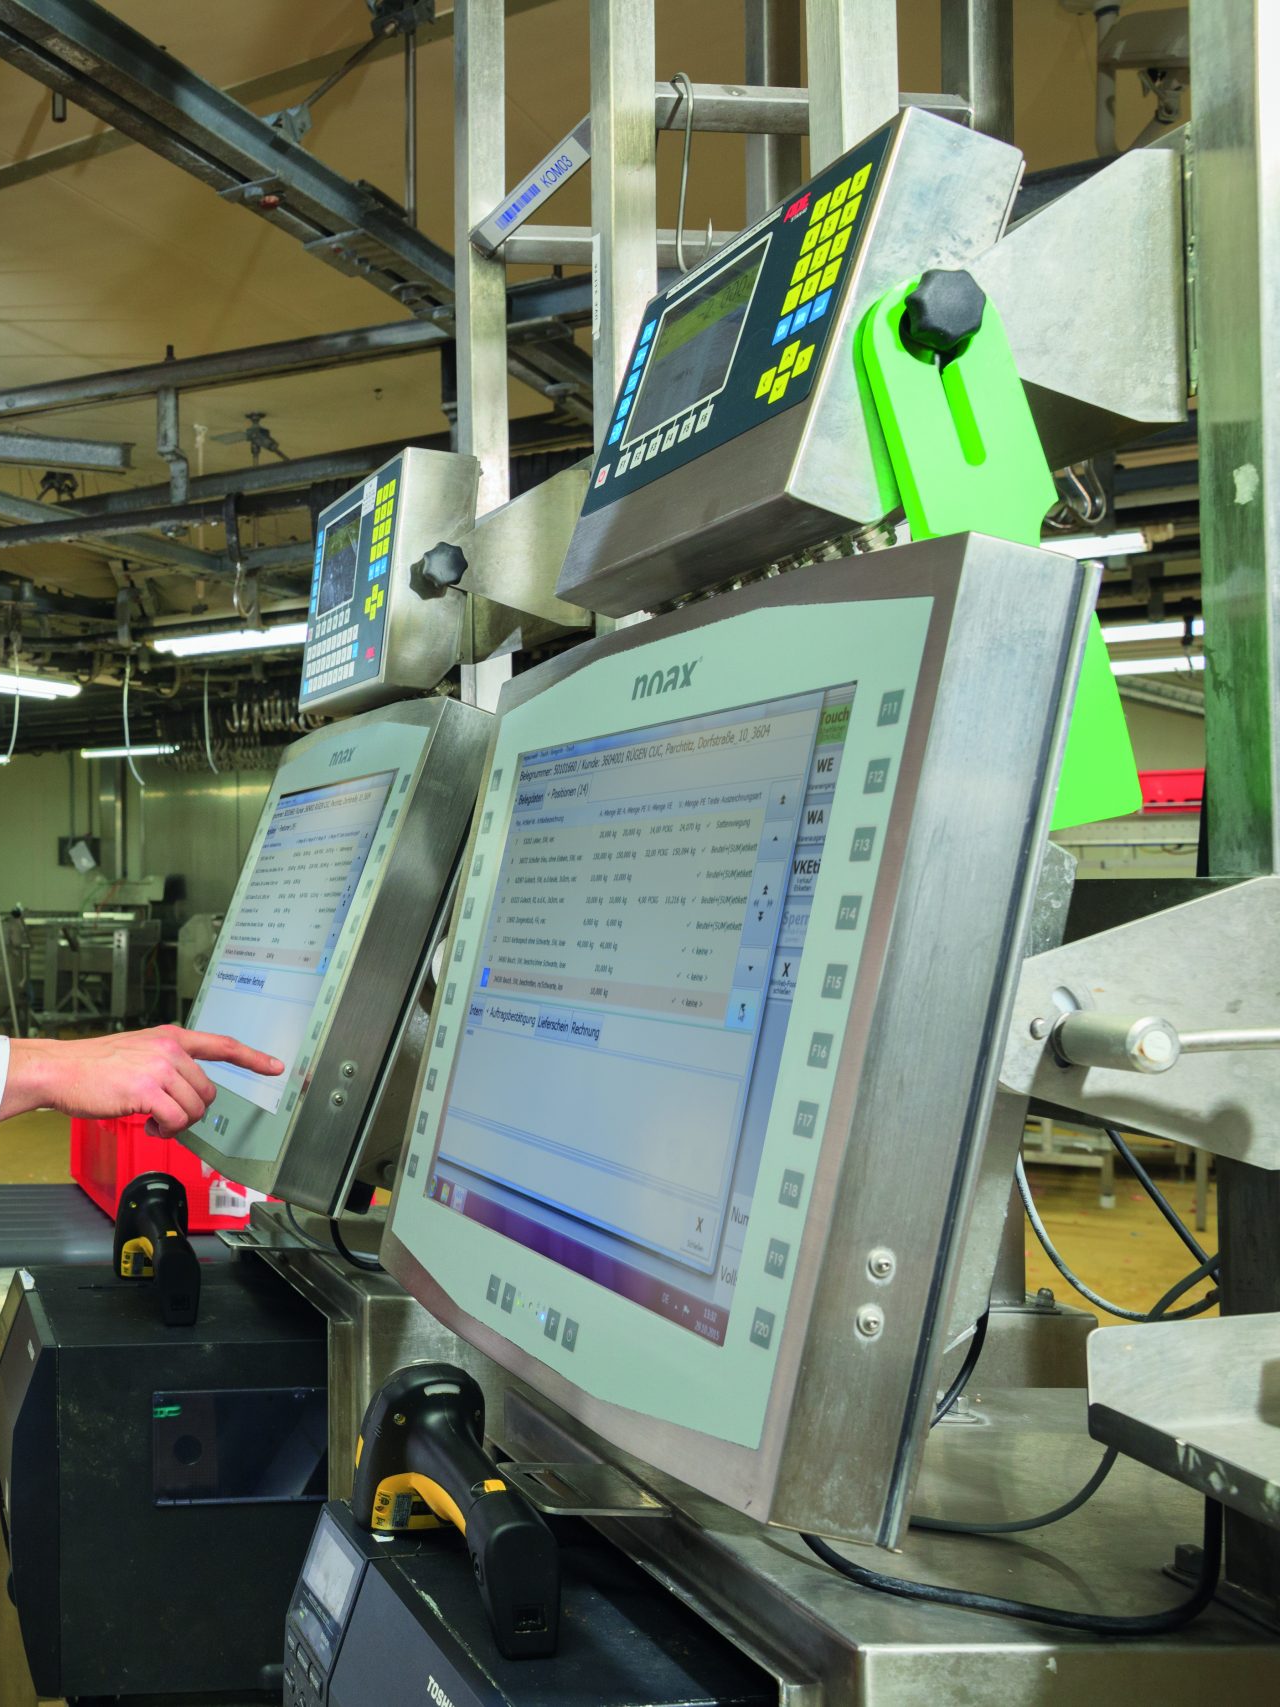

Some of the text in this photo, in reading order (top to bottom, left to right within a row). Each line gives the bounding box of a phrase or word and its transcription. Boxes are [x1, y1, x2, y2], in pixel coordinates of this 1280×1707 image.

[539, 155, 573, 188] KOM03
[631, 659, 698, 701] noax
[881, 701, 898, 717] F11
[817, 757, 834, 773] WE
[868, 770, 884, 784] F12
[807, 810, 824, 824] WA
[853, 838, 871, 852] F13
[839, 908, 856, 920] F14
[825, 975, 842, 989] F15
[469, 1004, 483, 1017] Intern
[537, 1016, 569, 1033] Lieferschein
[571, 1022, 600, 1041] Rechnung
[810, 1044, 827, 1059] F16
[796, 1112, 814, 1128] F17
[782, 1181, 799, 1198] F18
[768, 1250, 784, 1264] F19
[753, 1320, 768, 1338] F20
